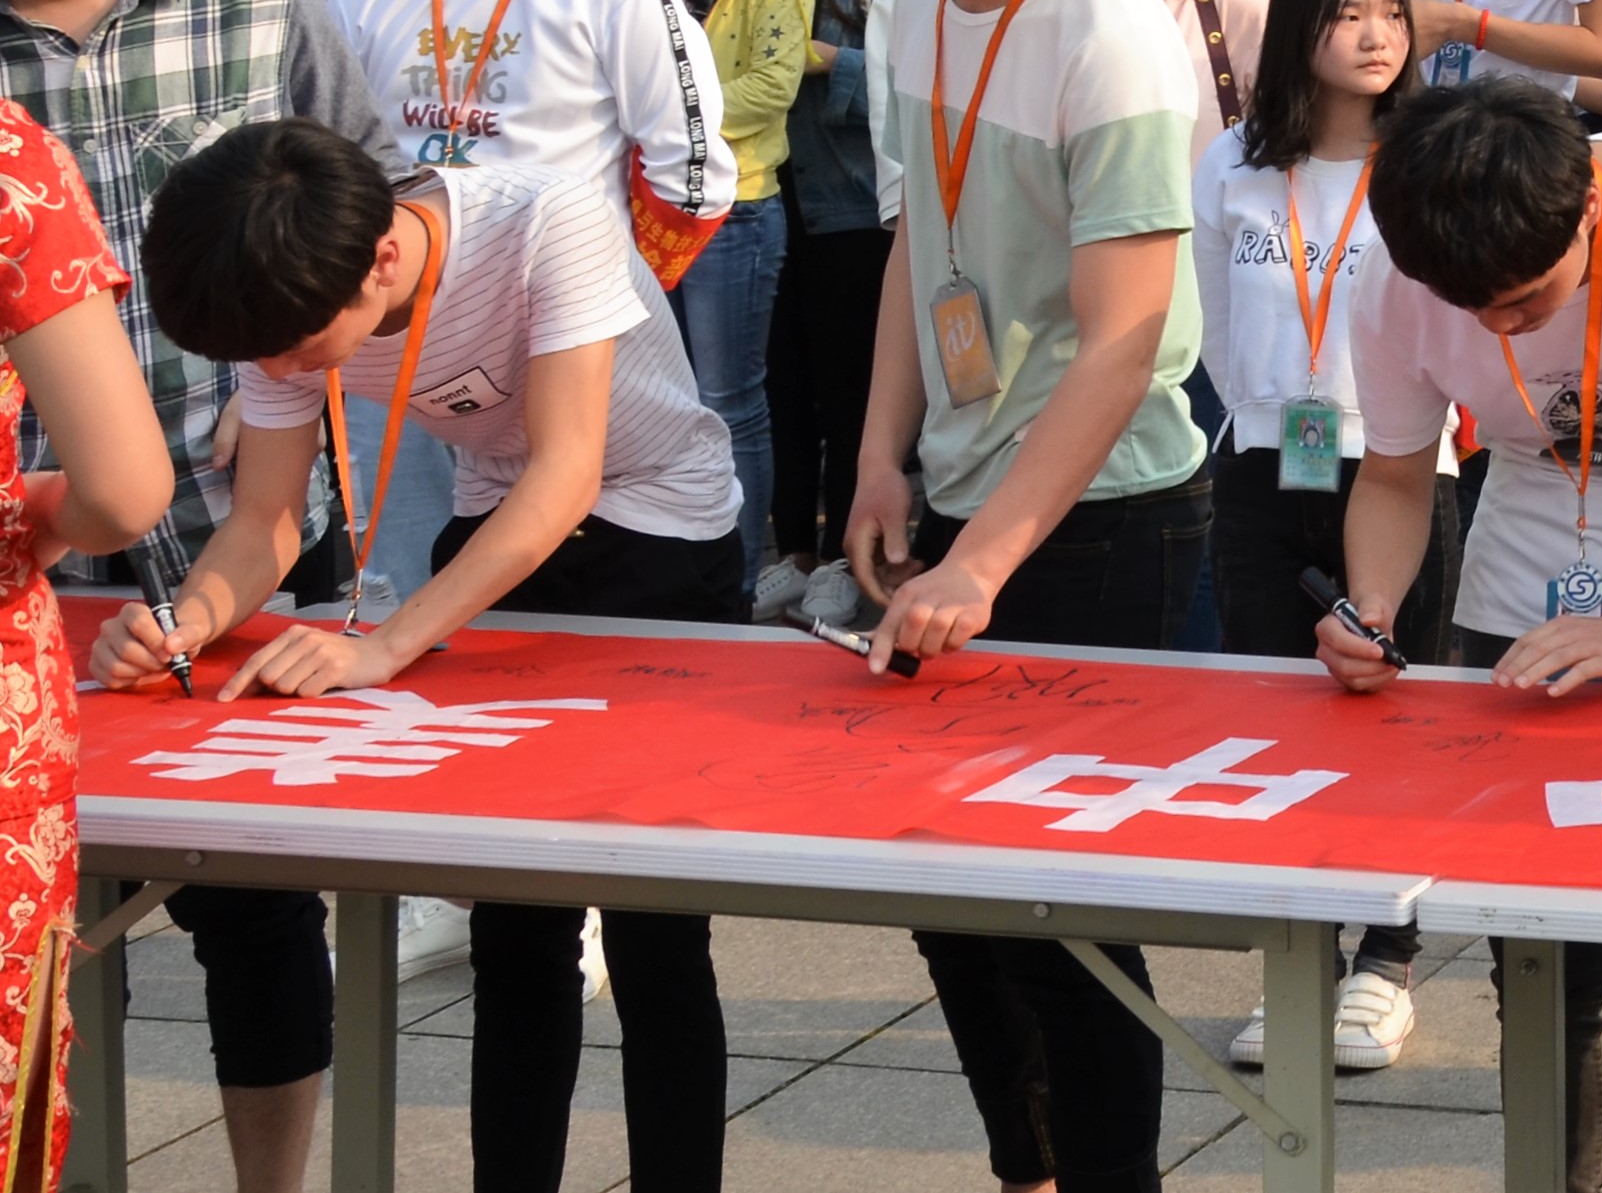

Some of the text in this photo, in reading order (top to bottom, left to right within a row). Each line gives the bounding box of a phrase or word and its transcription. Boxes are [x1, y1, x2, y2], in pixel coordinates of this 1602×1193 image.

[417, 25, 522, 63] EVERY
[679, 60, 694, 88] LONG
[466, 109, 501, 138] BE
[418, 132, 478, 165] OK
